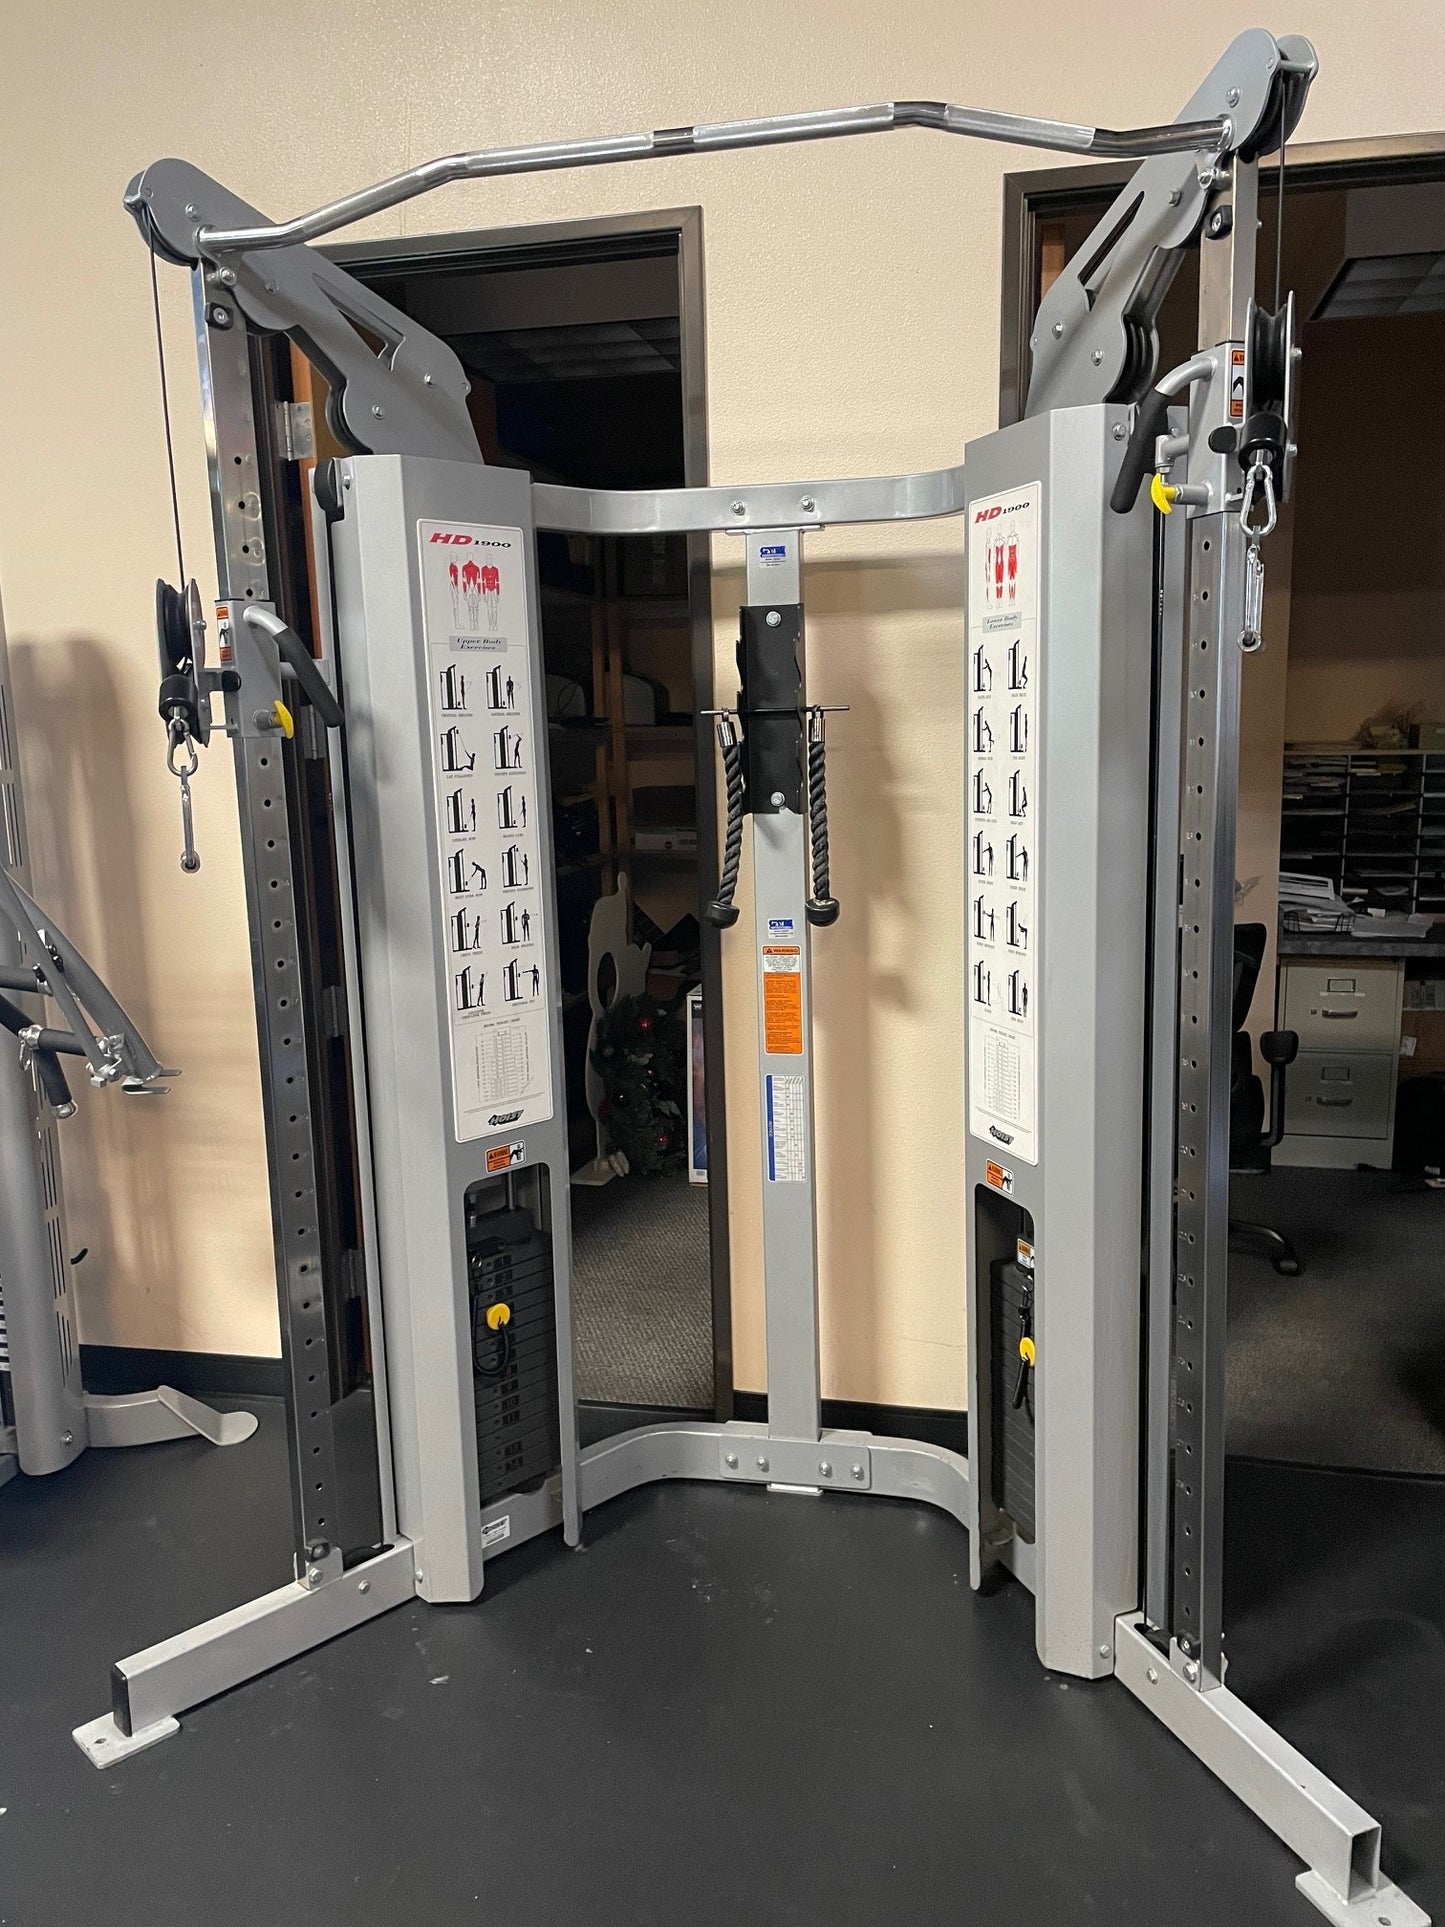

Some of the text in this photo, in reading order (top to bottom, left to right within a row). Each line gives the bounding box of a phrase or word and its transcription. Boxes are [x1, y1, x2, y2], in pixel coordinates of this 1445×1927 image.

[974, 502, 1030, 524] HD 1900
[429, 532, 511, 548] HD 1900
